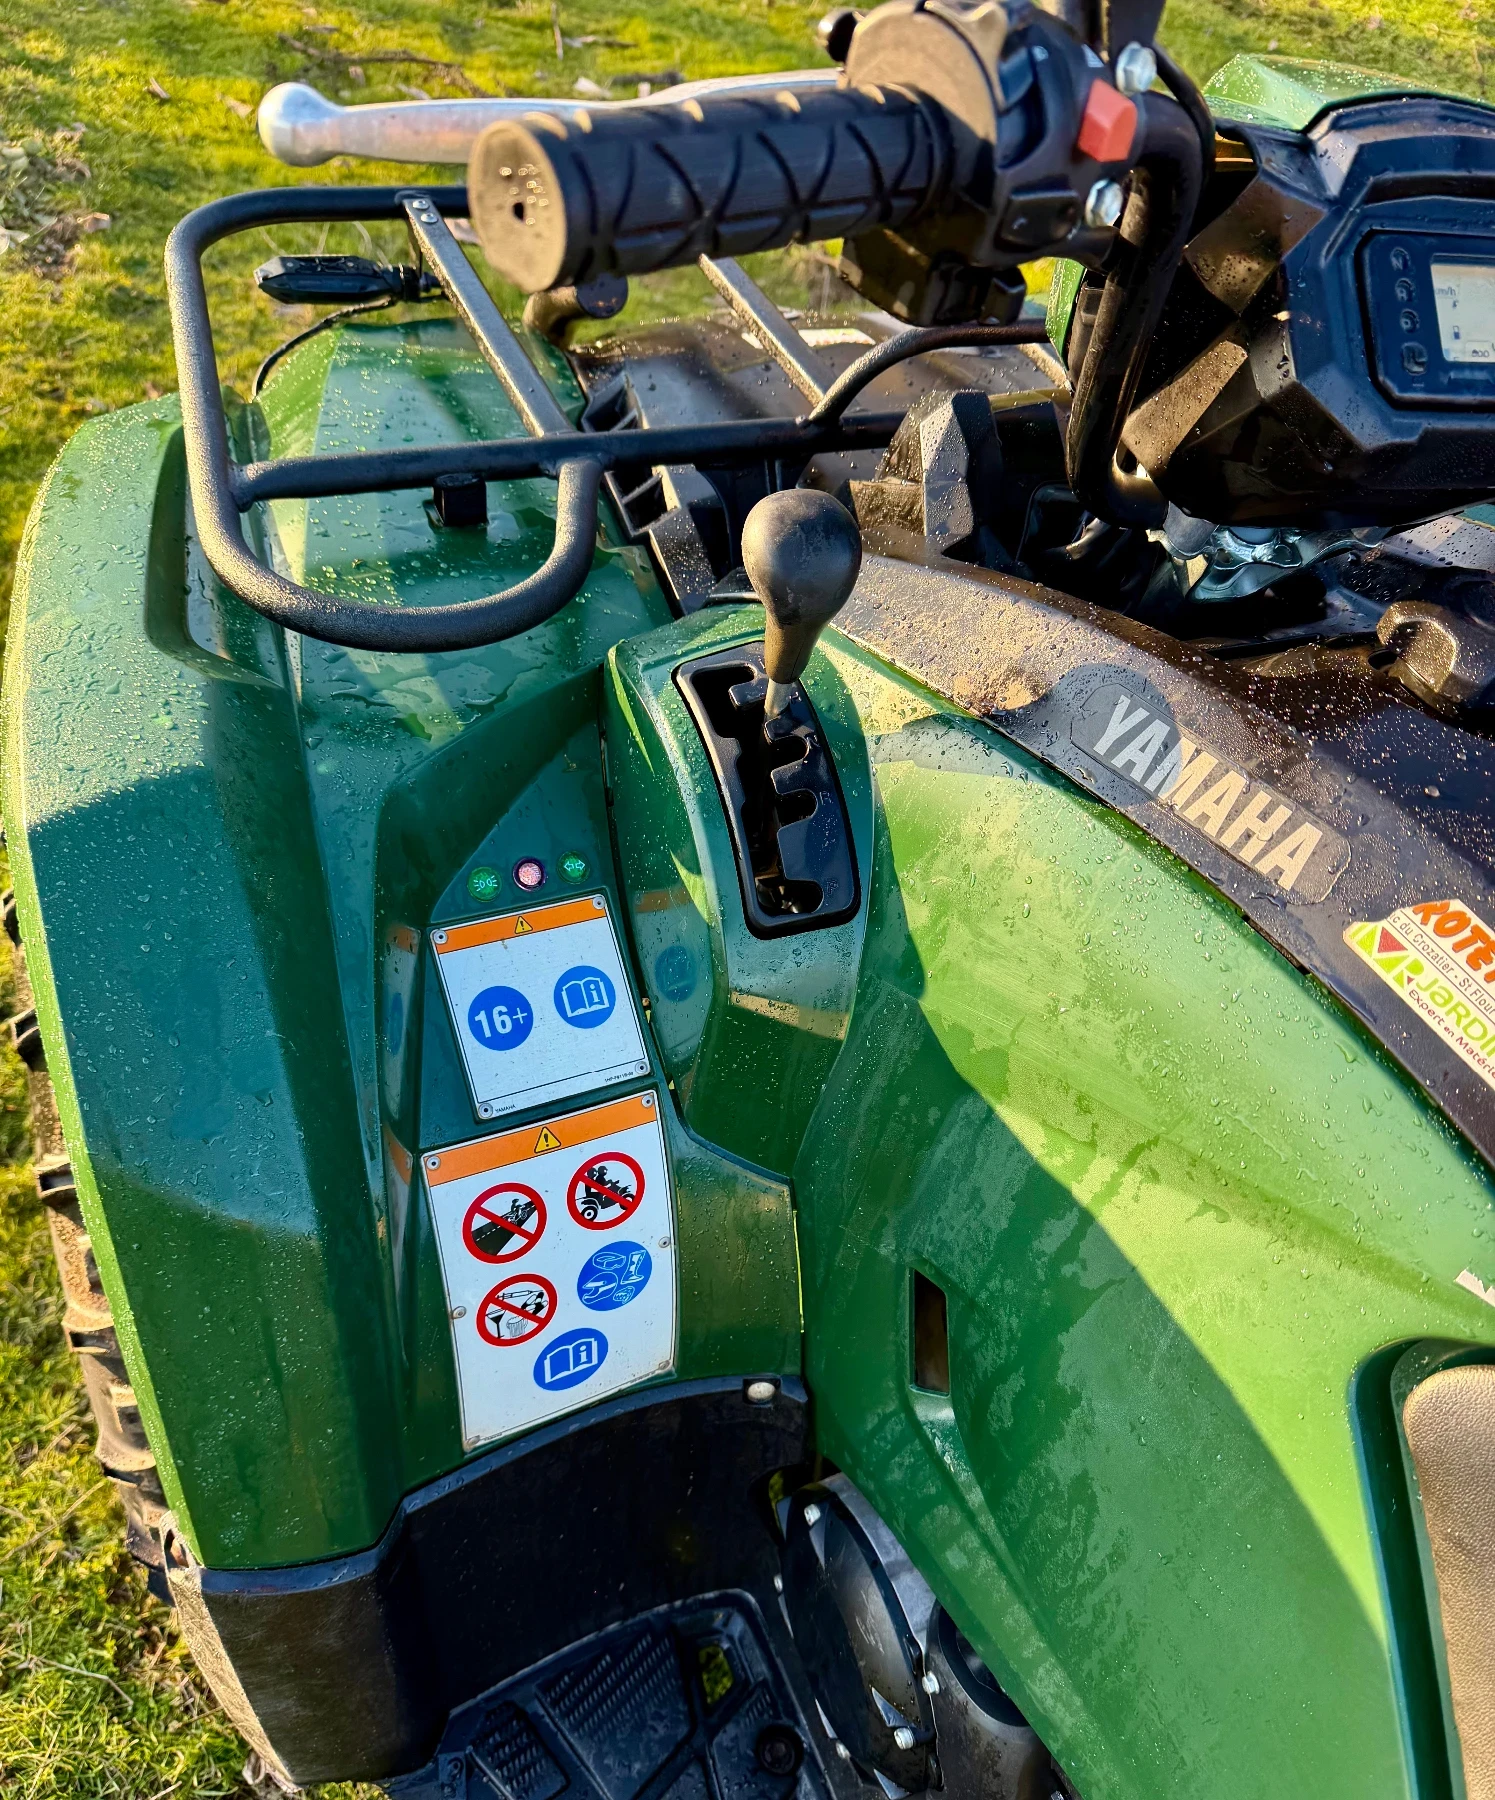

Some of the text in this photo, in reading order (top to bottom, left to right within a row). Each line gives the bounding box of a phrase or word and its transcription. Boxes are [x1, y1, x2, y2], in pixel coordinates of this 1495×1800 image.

[1093, 694, 1323, 891] YAMAHA
[1399, 922, 1414, 936] du
[1412, 933, 1455, 975] Crozatier
[1458, 977, 1473, 992] St
[1412, 900, 1495, 984] ROTE
[474, 1005, 528, 1039] 16+
[1408, 988, 1446, 1027] Expert
[1443, 1025, 1456, 1038] en
